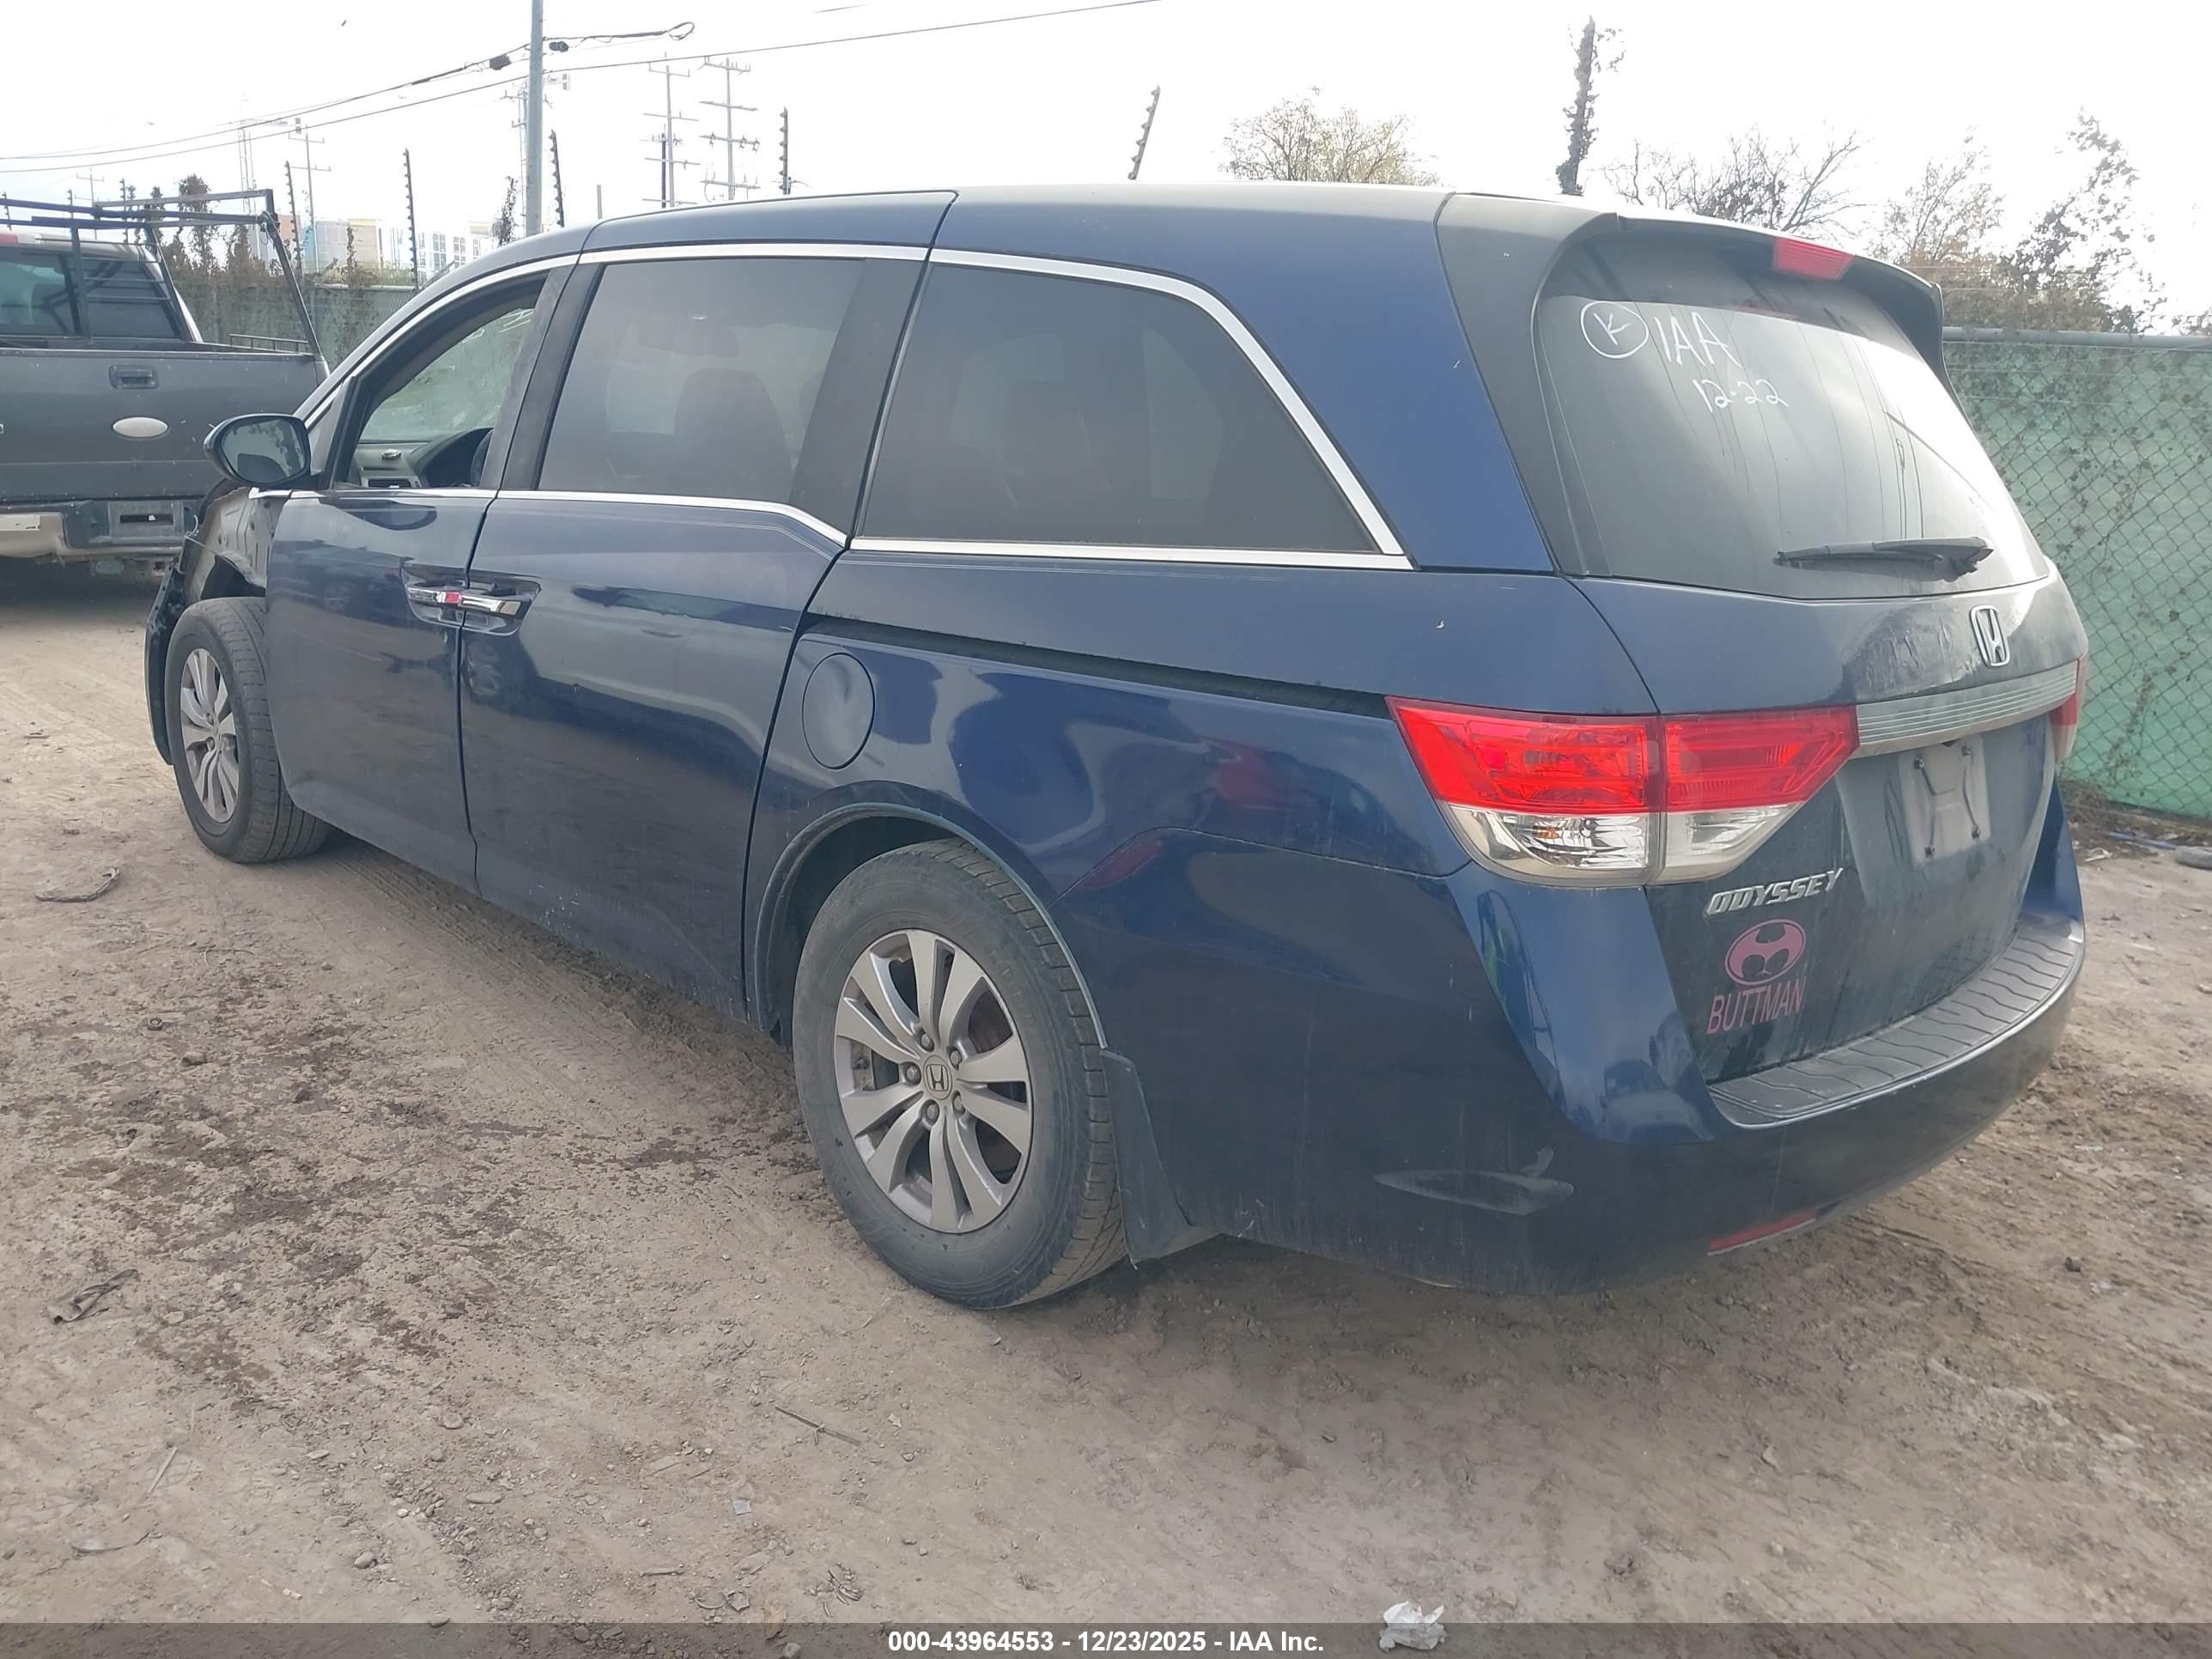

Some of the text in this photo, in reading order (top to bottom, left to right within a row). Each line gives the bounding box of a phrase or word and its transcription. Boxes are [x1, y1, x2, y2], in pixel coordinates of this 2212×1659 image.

[1654, 311, 1743, 369] IAA
[1705, 867, 1844, 915] ODYSSEY
[1706, 976, 1807, 1036] BUTTMAN
